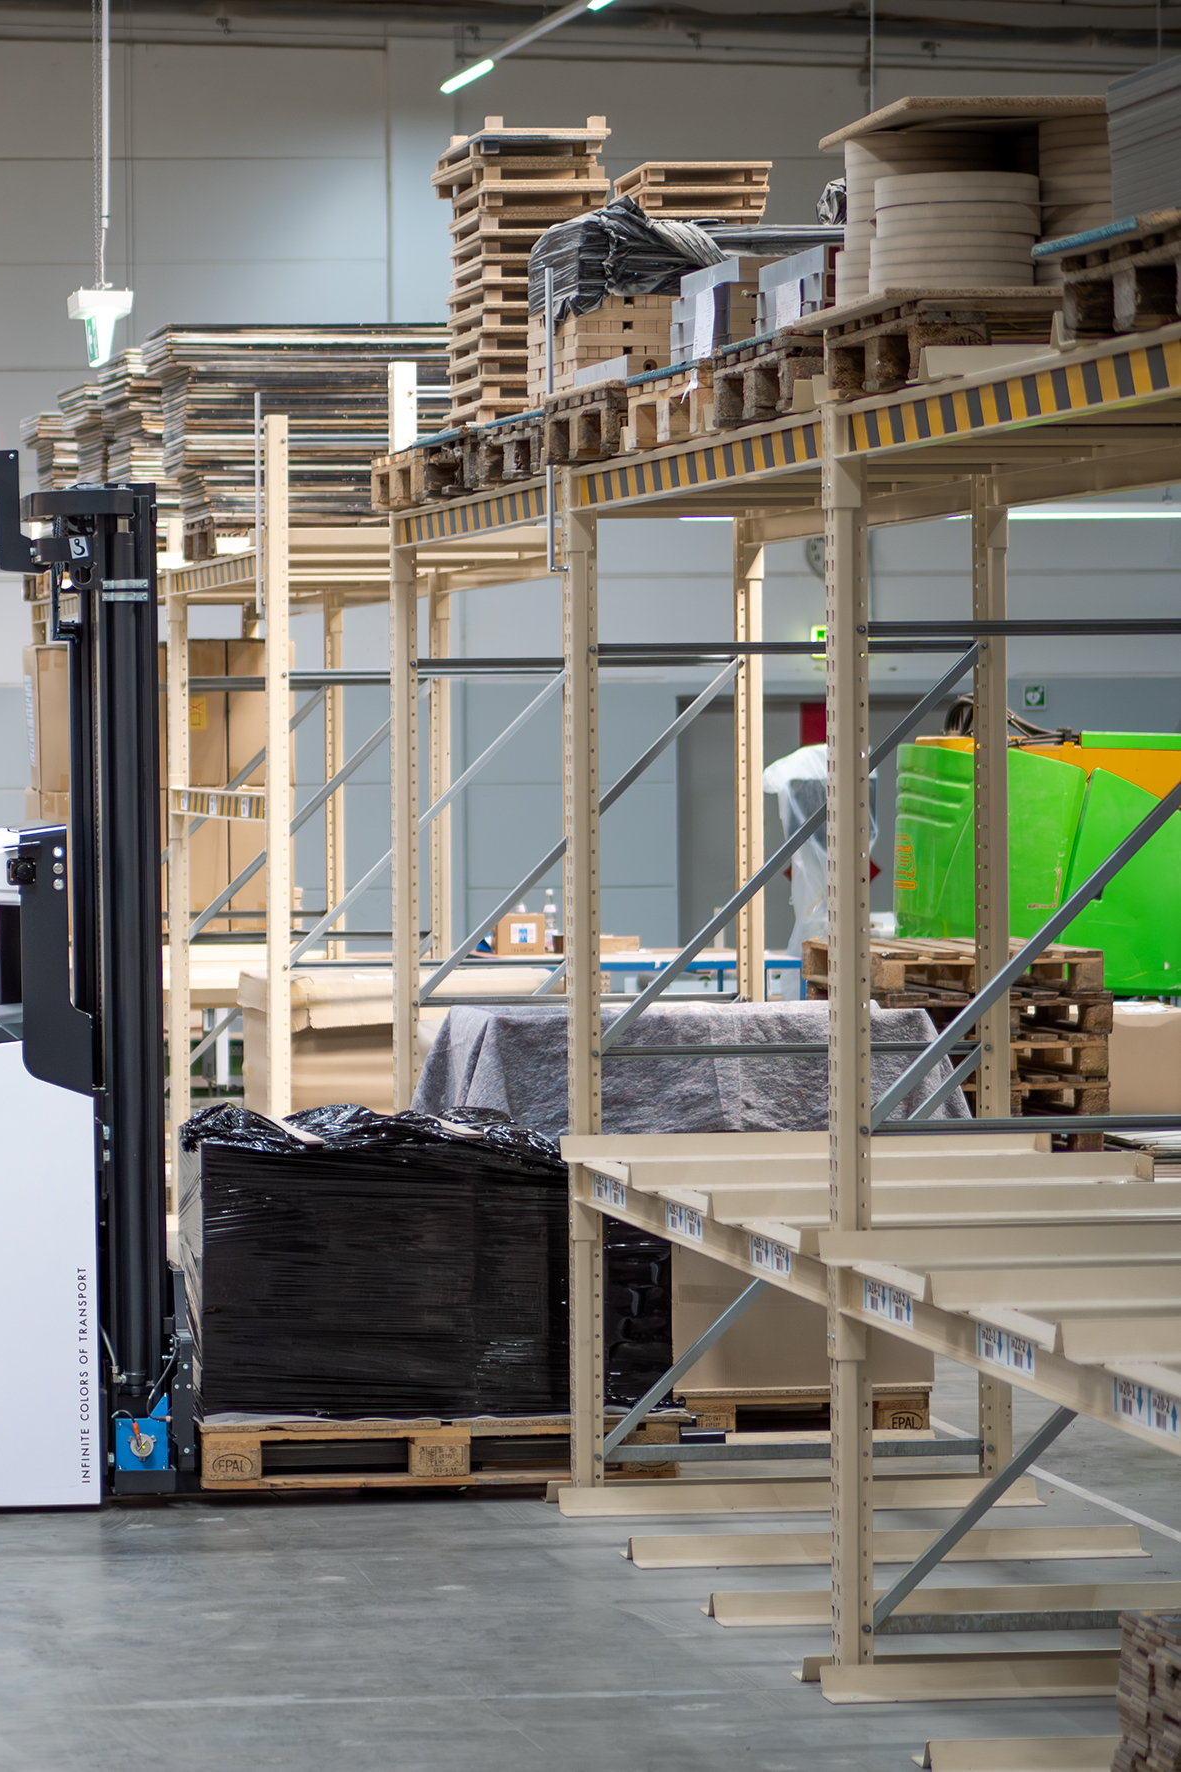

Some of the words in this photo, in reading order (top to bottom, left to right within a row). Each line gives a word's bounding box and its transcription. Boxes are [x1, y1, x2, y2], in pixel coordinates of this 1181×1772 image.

[77, 1267, 88, 1342] TRANSPORT
[78, 1348, 89, 1365] OF
[79, 1371, 90, 1422] COLORS
[891, 1416, 919, 1430] EPAL
[80, 1428, 91, 1484] INFINITE
[218, 1459, 246, 1473] EPAL
